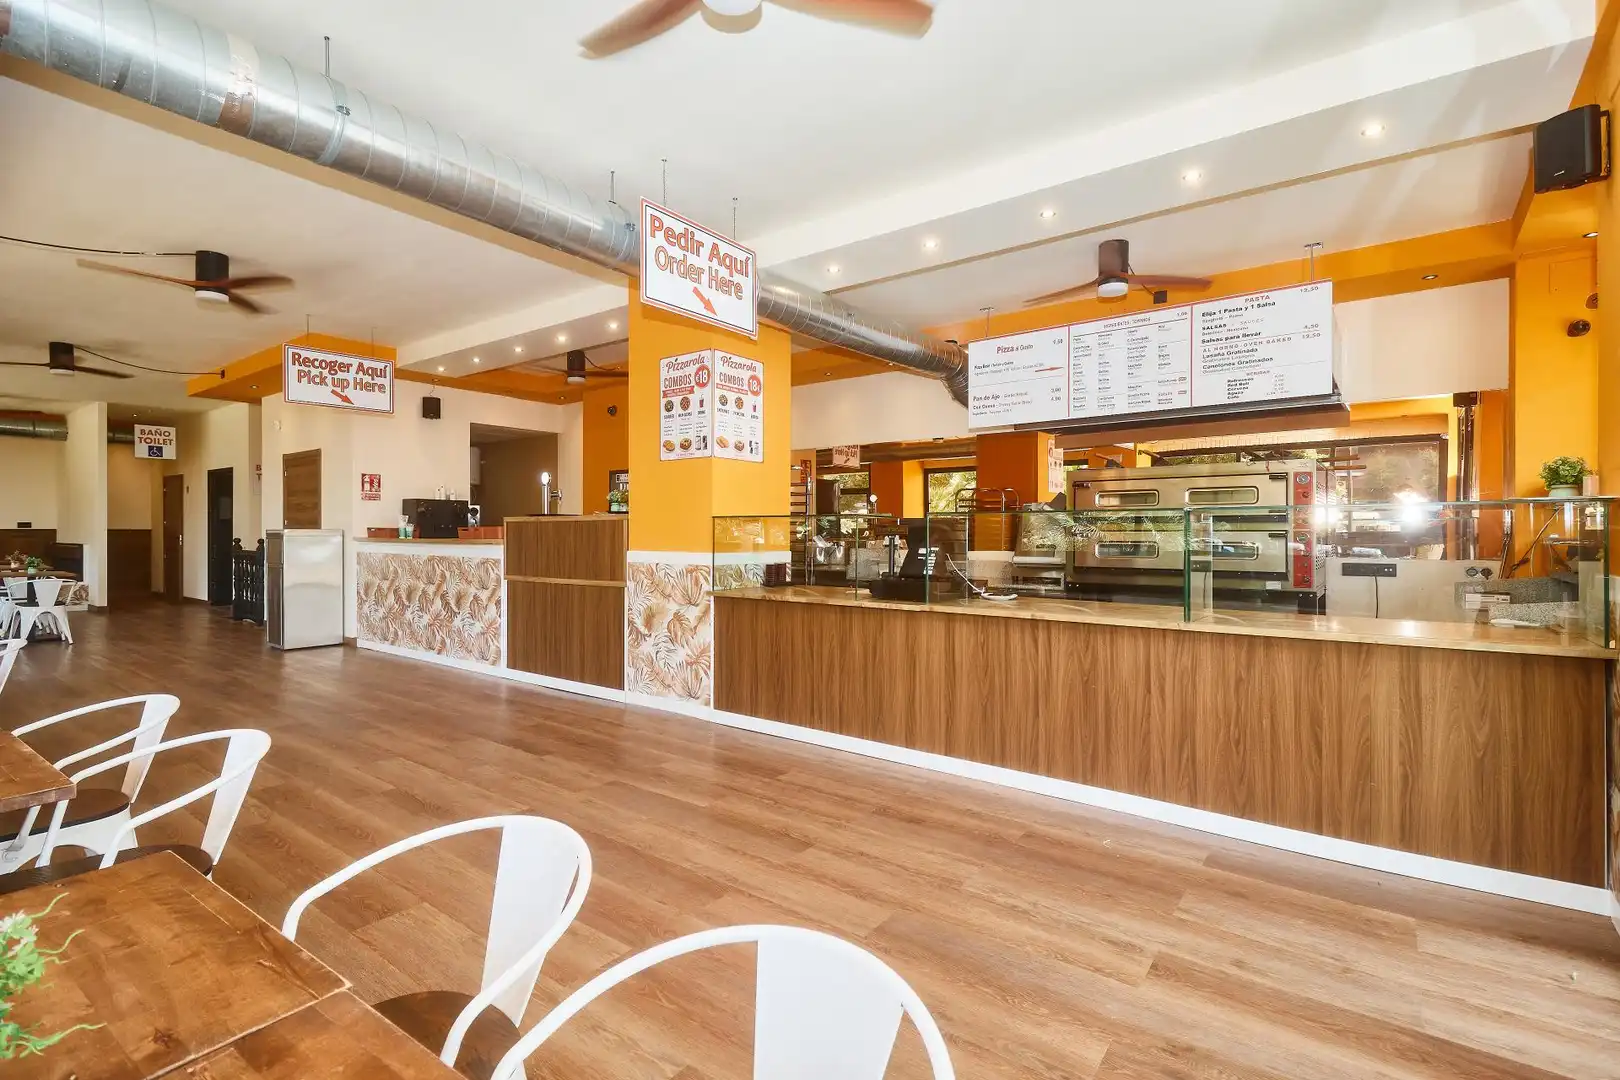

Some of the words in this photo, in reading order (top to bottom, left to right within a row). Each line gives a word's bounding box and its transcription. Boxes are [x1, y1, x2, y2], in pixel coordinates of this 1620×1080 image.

[650, 214, 704, 257] Pedir
[708, 242, 751, 278] Aquí
[654, 245, 705, 285] Order
[708, 266, 743, 300] Here
[1244, 295, 1271, 303] PASTA
[1224, 306, 1243, 314] Pasta
[1201, 336, 1223, 344] Salsas
[1225, 334, 1240, 342] para
[1241, 331, 1262, 339] llevar
[996, 345, 1014, 354] Pizza
[1226, 347, 1258, 356] Gratinada
[291, 351, 353, 376] Recoger
[355, 361, 388, 381] Aquí
[665, 354, 706, 374] Pizzarola
[720, 355, 757, 373] Pizzarola
[297, 369, 329, 387] Pick
[331, 377, 350, 393] up
[353, 377, 387, 394] Here
[664, 373, 692, 389] COMBOS
[719, 372, 744, 388] COMBOS
[140, 428, 171, 437] BAÑO
[137, 436, 174, 446] TOILET
